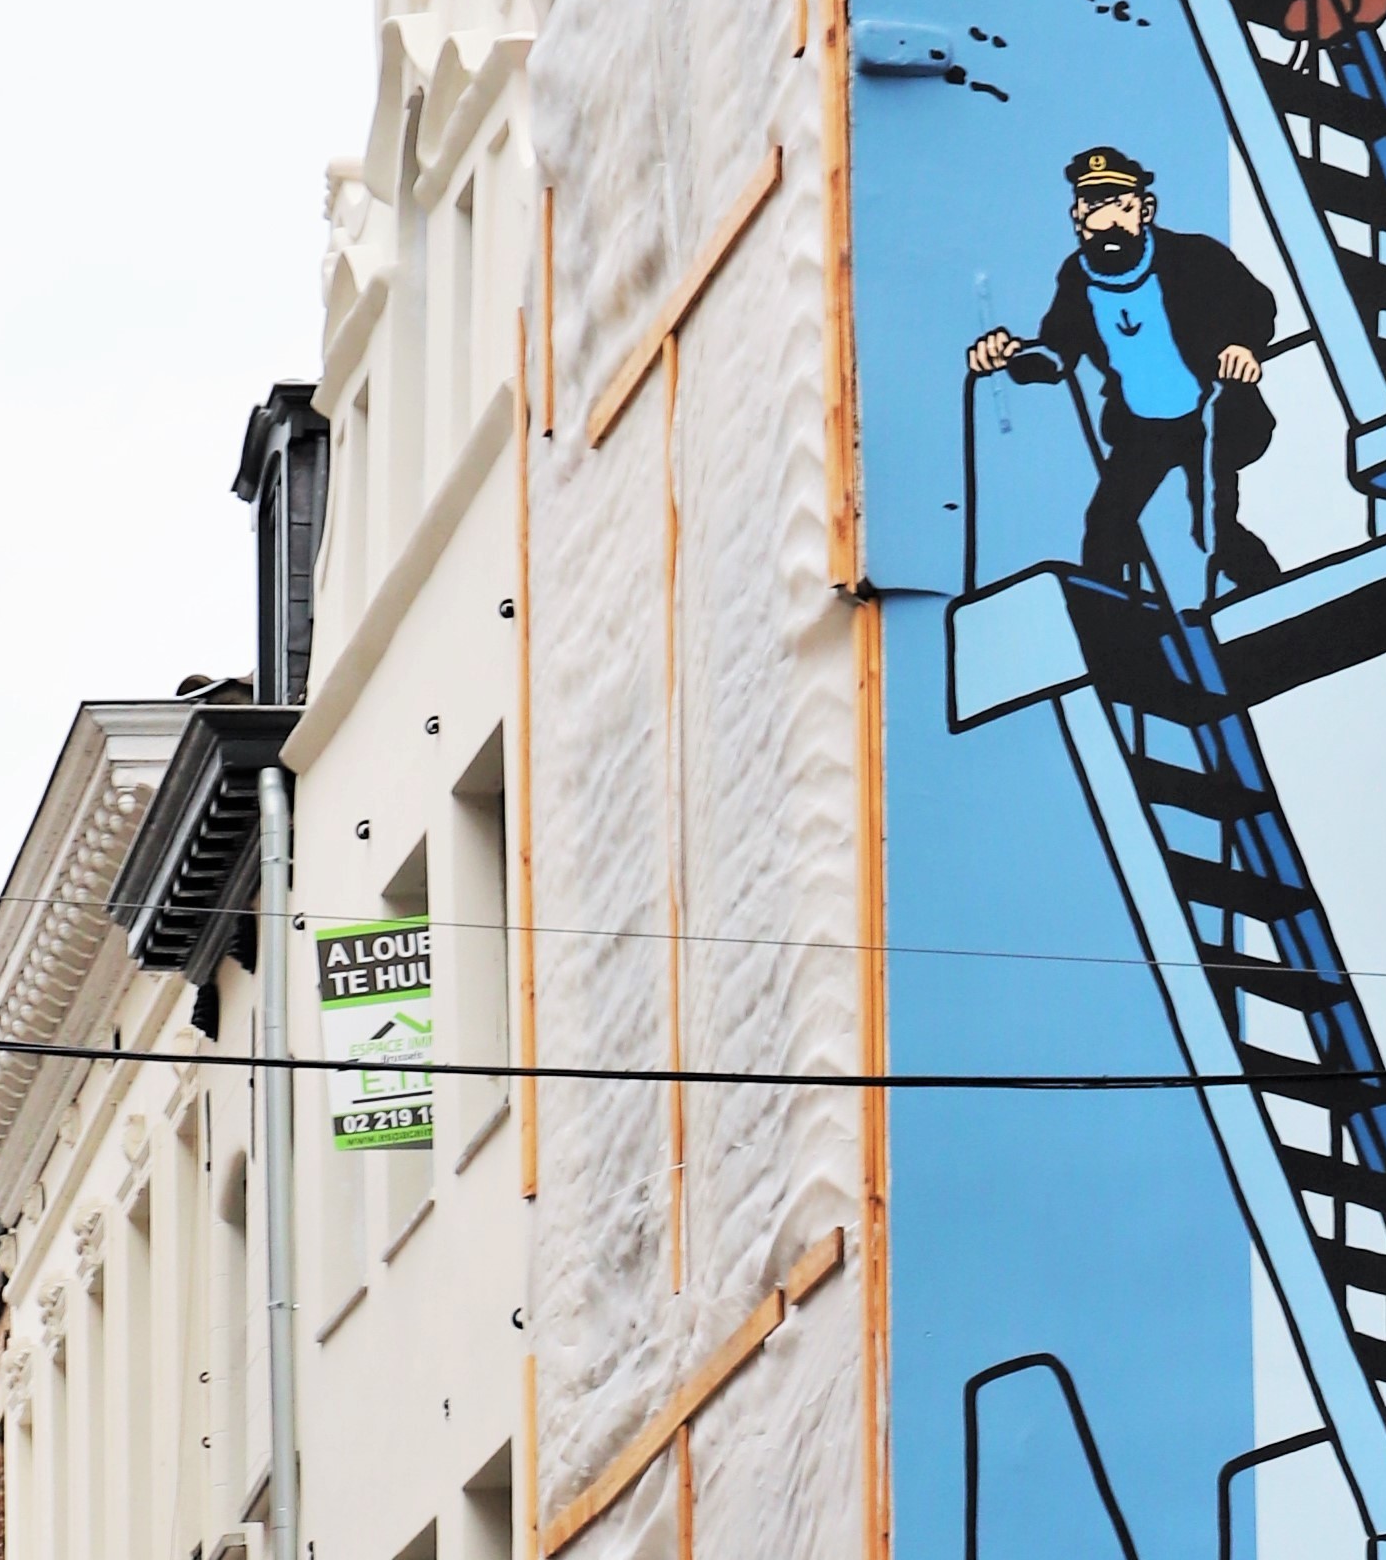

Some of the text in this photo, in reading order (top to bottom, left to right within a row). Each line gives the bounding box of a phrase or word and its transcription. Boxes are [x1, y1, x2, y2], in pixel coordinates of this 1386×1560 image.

[326, 943, 350, 968] A
[328, 970, 369, 996] TE
[342, 1104, 432, 1134] 02 219 1
